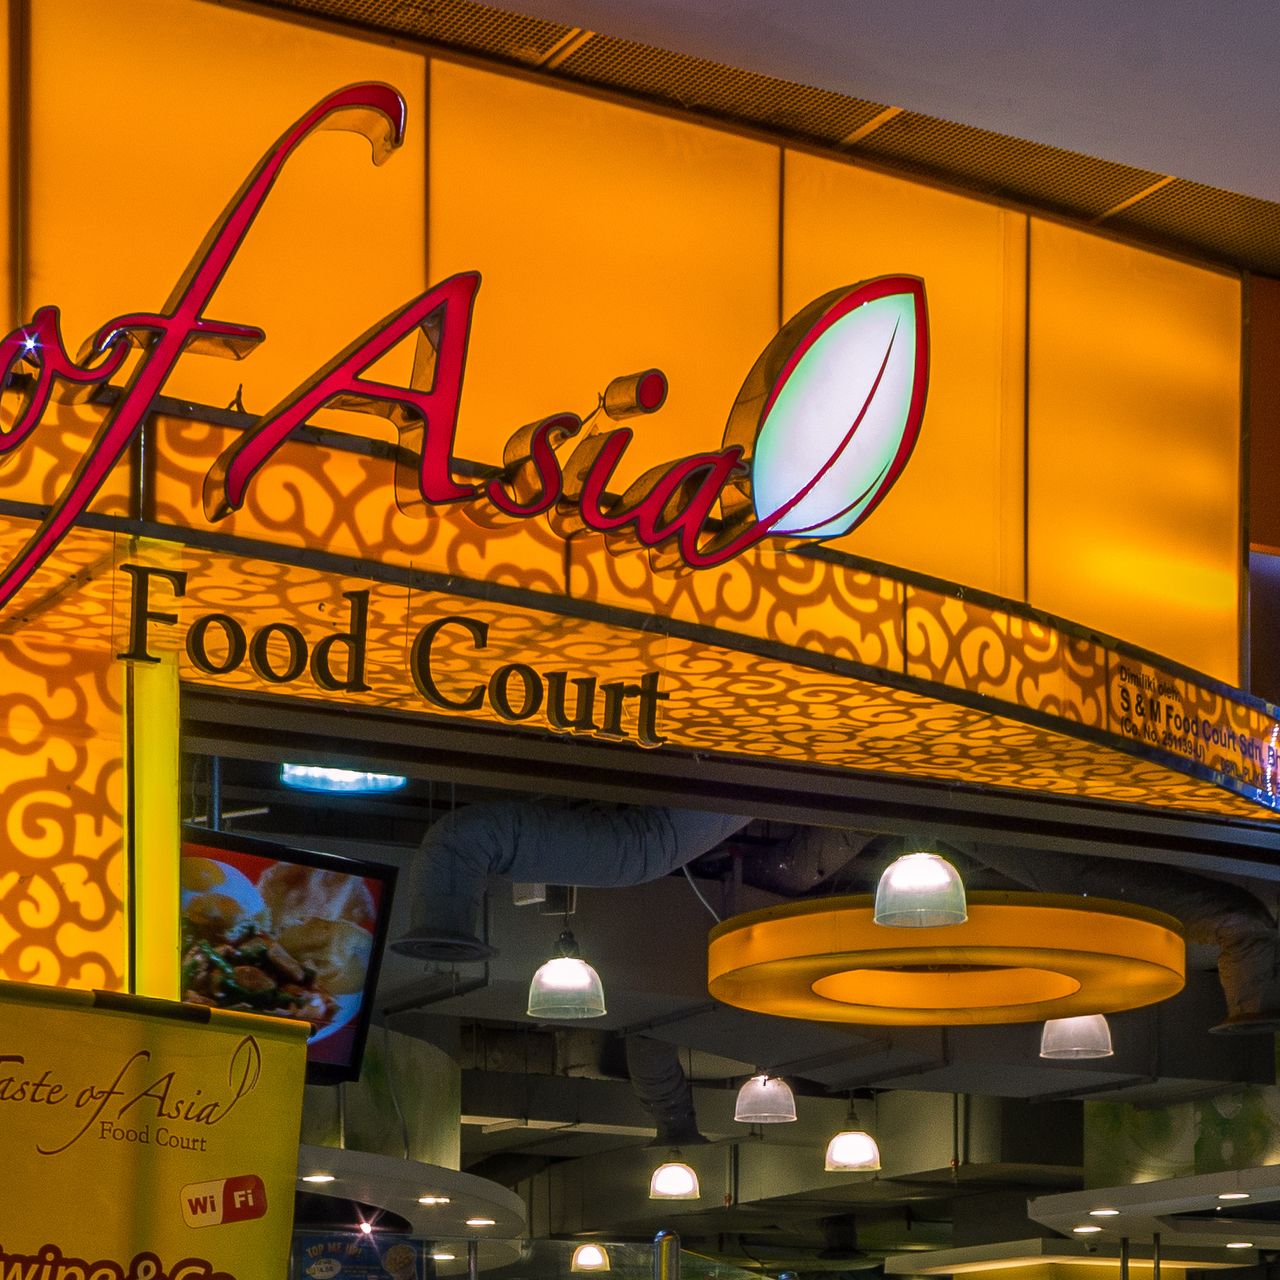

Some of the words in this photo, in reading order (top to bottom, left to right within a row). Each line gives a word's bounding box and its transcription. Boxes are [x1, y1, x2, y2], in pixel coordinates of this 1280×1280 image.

[208, 270, 770, 572] Asia
[117, 563, 372, 694] Food
[409, 615, 672, 747] Court
[1120, 665, 1157, 694] Dimiliki
[1120, 687, 1130, 712] S
[1135, 694, 1144, 717] &
[1150, 698, 1162, 724] M
[1166, 705, 1198, 738] Food
[1202, 721, 1236, 751] Court
[36, 1050, 150, 1155] of
[117, 1071, 224, 1126] Asia
[99, 1121, 149, 1144] Food
[155, 1127, 207, 1152] Court
[187, 1194, 217, 1216] Wi
[233, 1189, 254, 1208] Fi
